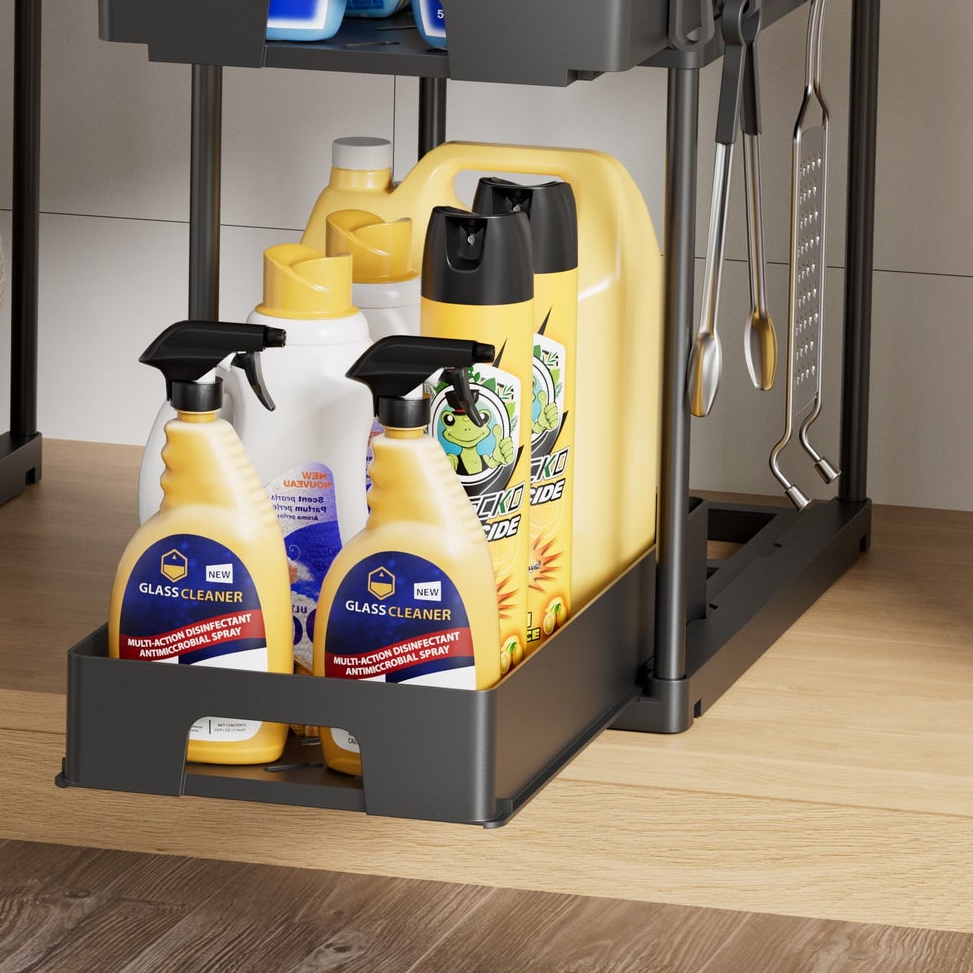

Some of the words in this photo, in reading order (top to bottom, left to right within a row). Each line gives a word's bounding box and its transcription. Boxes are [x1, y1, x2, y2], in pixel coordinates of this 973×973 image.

[208, 569, 231, 580] NEW
[139, 582, 179, 598] GLASS
[181, 588, 243, 603] CLEANER
[416, 587, 440, 598] NEW
[345, 600, 387, 616] GLASS
[388, 605, 452, 621] CLEANER
[127, 630, 186, 647] MULTI-ACTION
[185, 613, 252, 638] DISINFECTANT
[139, 637, 211, 658] ANTIMICCROBIAL
[211, 626, 242, 642] SPRAY
[333, 649, 393, 666] MULTI-ACTION
[392, 631, 460, 655] DISINFECTANT
[345, 656, 419, 677] ANTIMICCROBIAL
[419, 644, 450, 659] SPRAY
